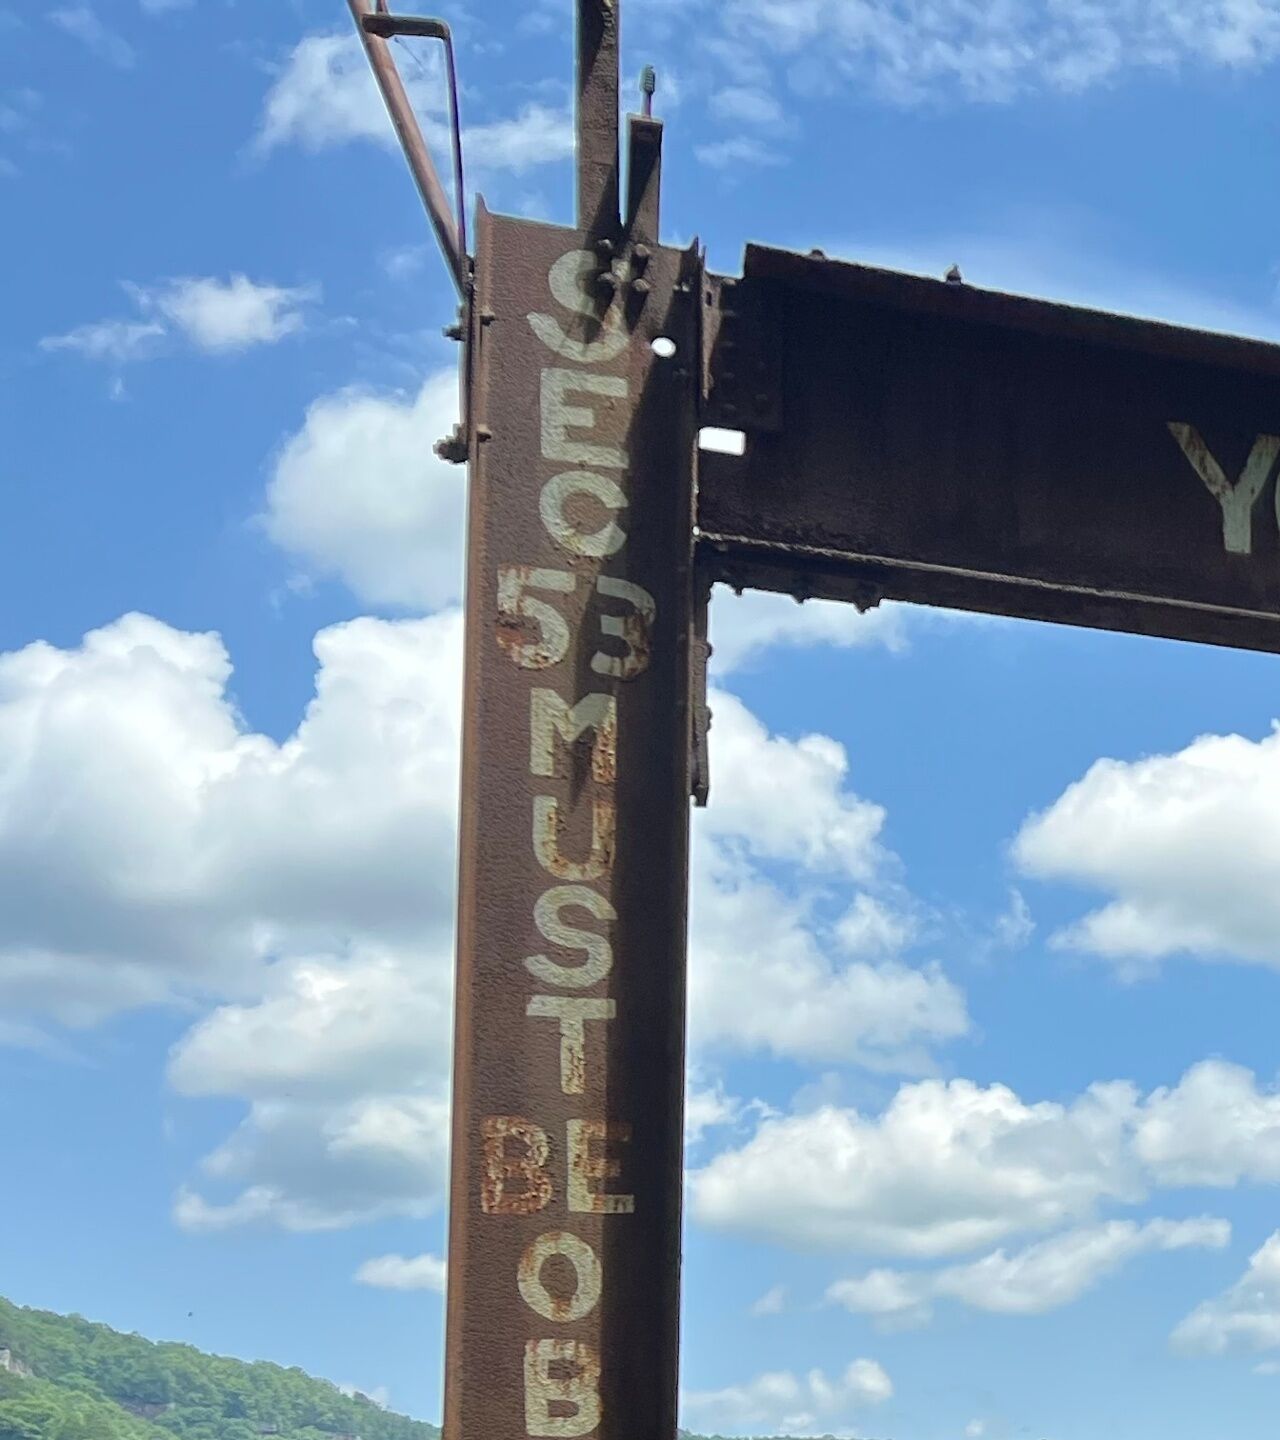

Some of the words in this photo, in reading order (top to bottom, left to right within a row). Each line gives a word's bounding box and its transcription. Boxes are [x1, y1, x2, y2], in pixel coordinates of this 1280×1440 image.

[526, 249, 632, 557] SEC
[495, 564, 657, 682] 53
[525, 686, 618, 1097] MUST
[481, 1115, 635, 1214] BE
